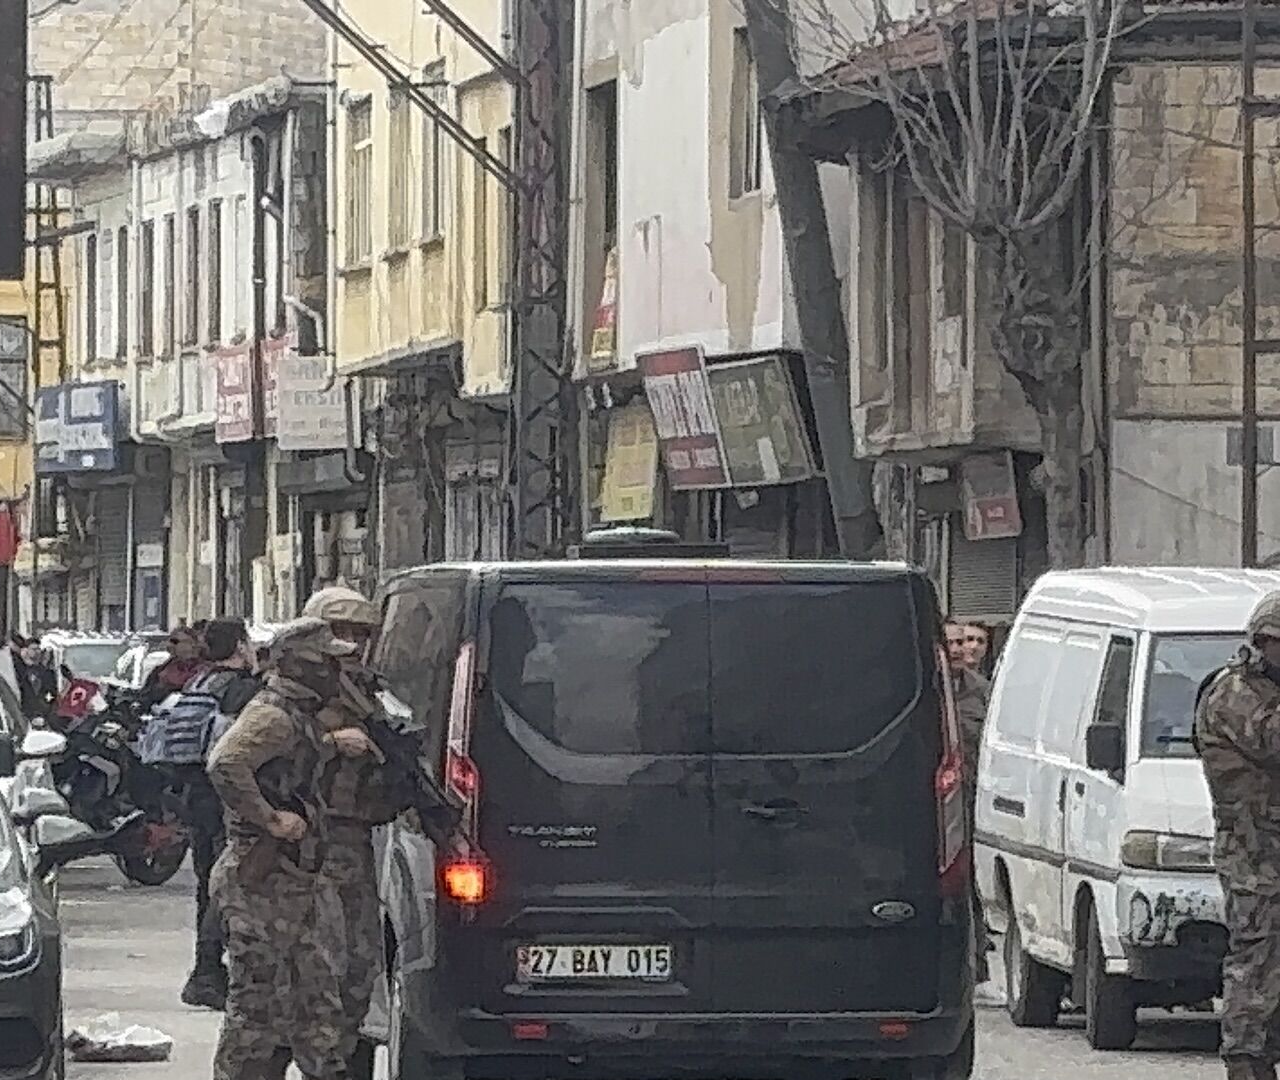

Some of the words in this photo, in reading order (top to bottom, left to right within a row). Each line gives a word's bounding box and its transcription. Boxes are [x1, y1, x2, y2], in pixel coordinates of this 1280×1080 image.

[531, 949, 557, 974] 27
[573, 949, 612, 974] BAY
[627, 949, 669, 974] 015
